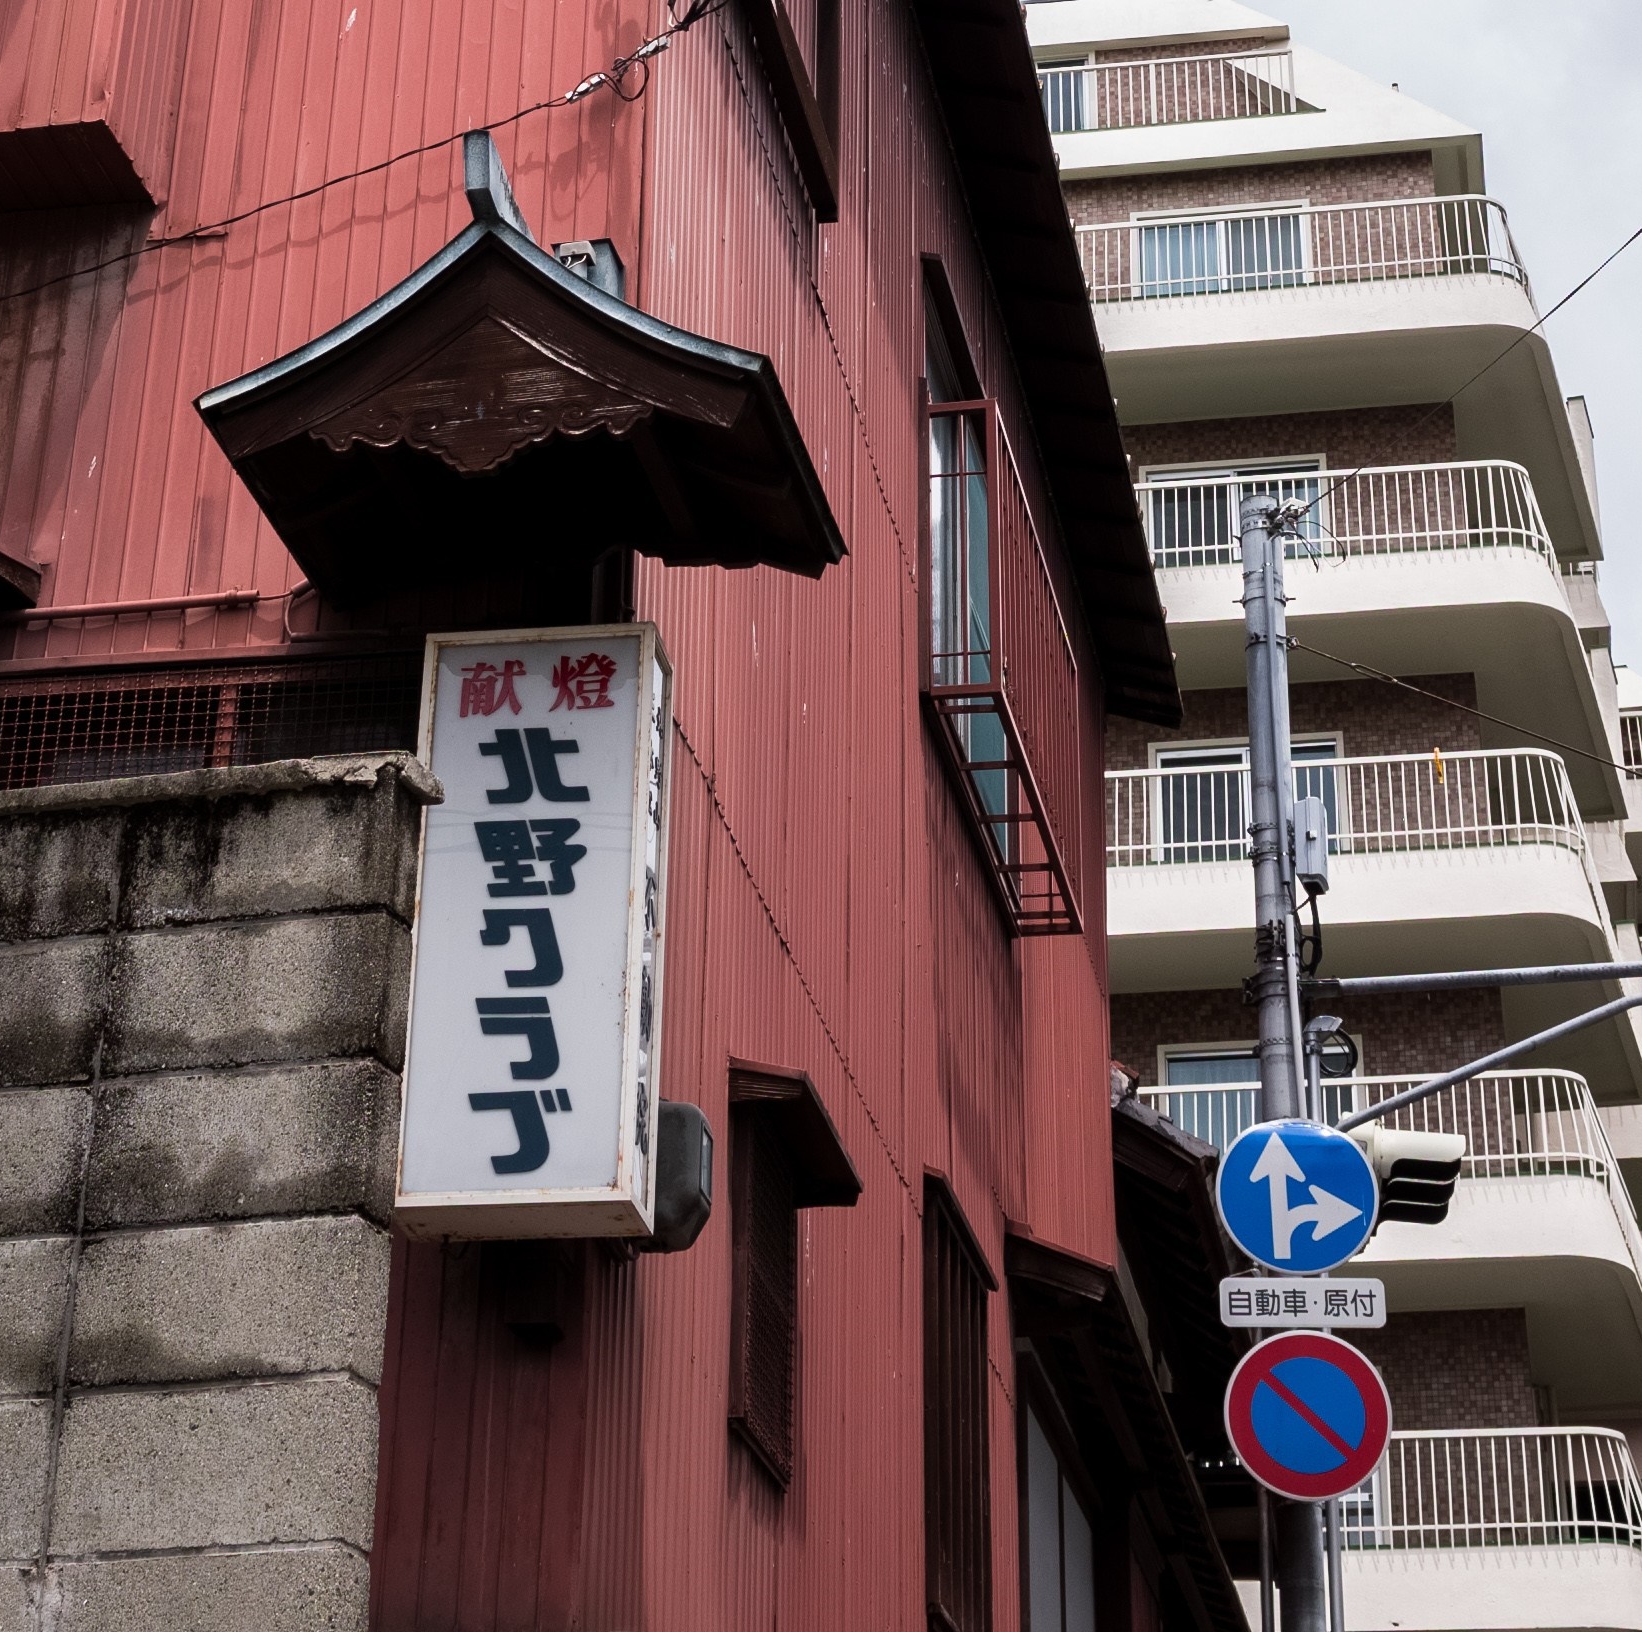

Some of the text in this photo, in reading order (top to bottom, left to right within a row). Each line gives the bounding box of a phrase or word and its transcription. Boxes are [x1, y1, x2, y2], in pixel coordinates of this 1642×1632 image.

[459, 652, 617, 718] 献燈
[468, 727, 591, 1174] 北野クラブ
[1229, 1288, 1376, 1317] 自動車・原付
